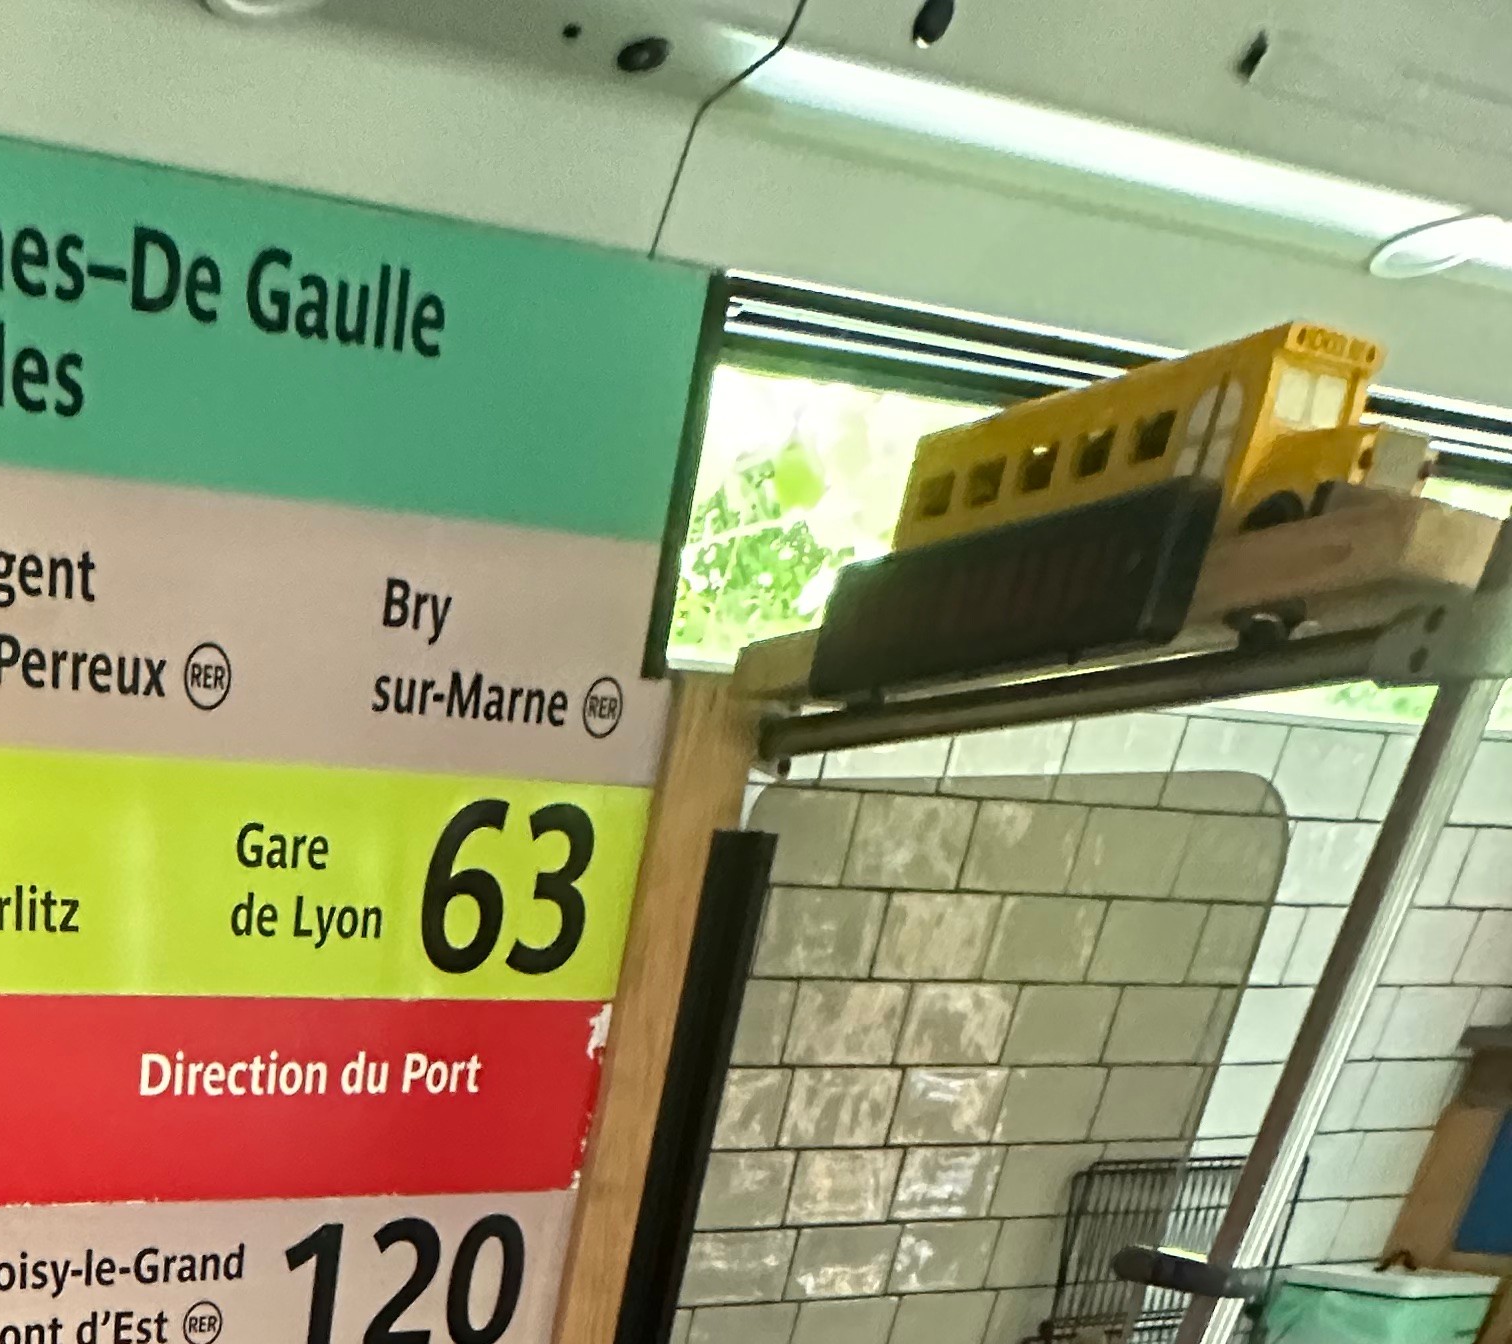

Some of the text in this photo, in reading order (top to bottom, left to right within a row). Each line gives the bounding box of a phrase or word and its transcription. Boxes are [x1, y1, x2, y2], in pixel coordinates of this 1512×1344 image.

[245, 247, 446, 359] Gaulle
[382, 578, 451, 645] Bry
[372, 671, 569, 727] sur-Marne
[235, 824, 329, 871] Gare
[419, 798, 596, 977] 63
[231, 893, 384, 947] de Lyon
[139, 1051, 482, 1098] Direction du Port
